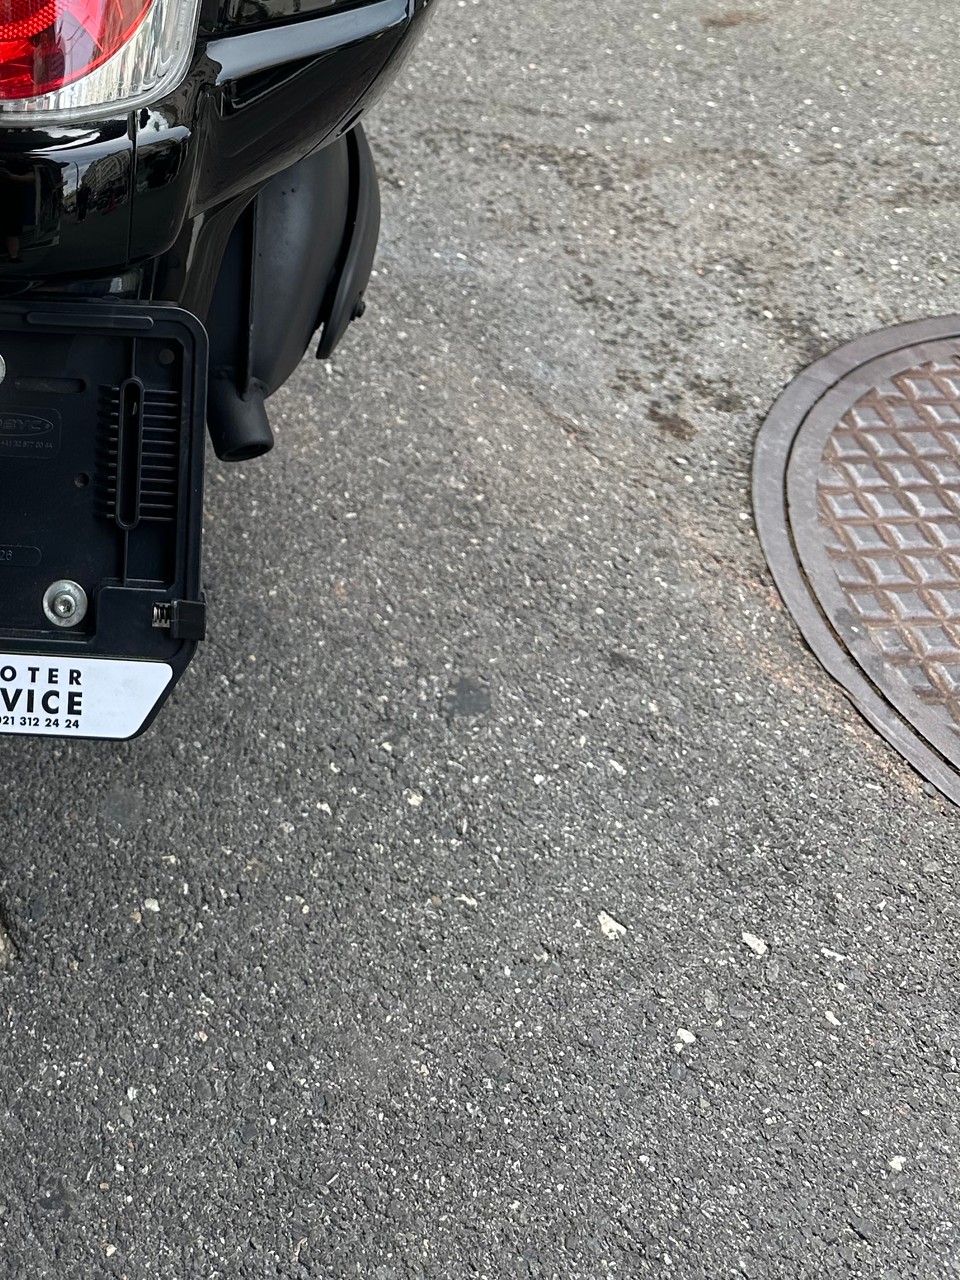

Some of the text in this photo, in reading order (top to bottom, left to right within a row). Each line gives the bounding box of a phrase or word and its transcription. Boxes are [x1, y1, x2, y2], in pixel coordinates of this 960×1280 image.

[19, 716, 40, 727] 312
[44, 718, 60, 728] 24
[64, 719, 80, 729] 24
